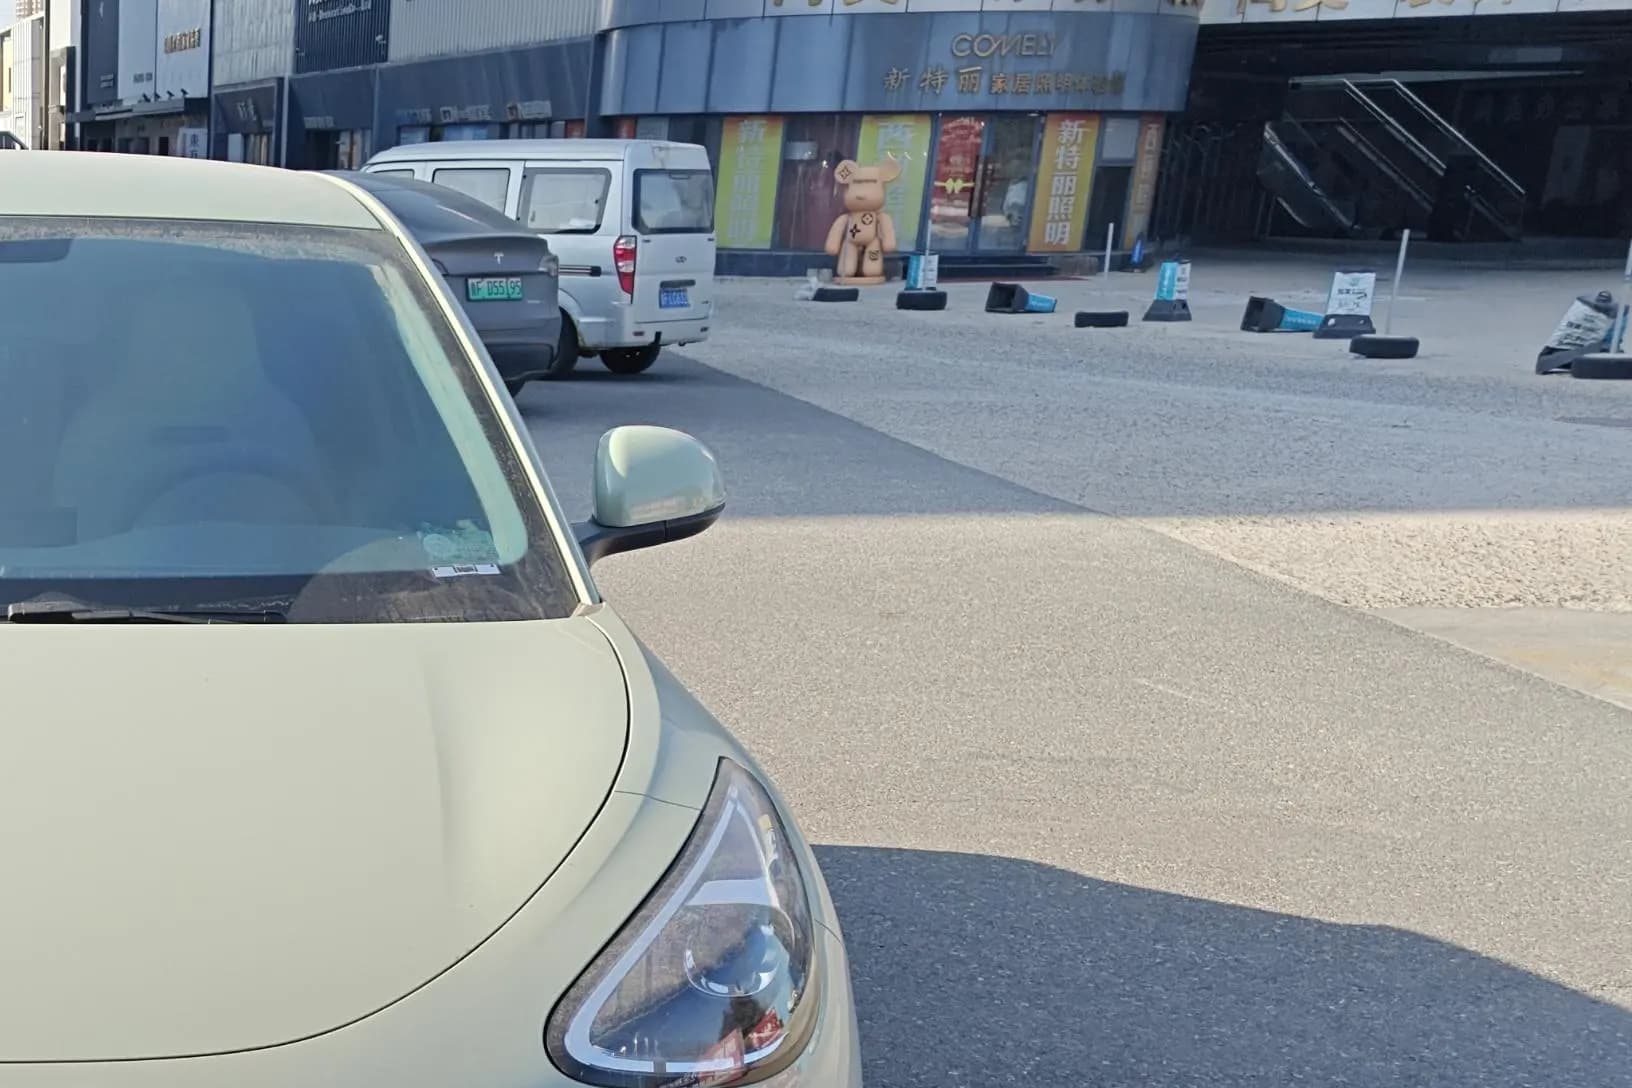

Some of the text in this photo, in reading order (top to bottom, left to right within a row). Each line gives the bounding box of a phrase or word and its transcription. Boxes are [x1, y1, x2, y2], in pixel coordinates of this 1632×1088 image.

[951, 34, 1058, 57] COMELY
[1043, 119, 1087, 246] 新特丽照明
